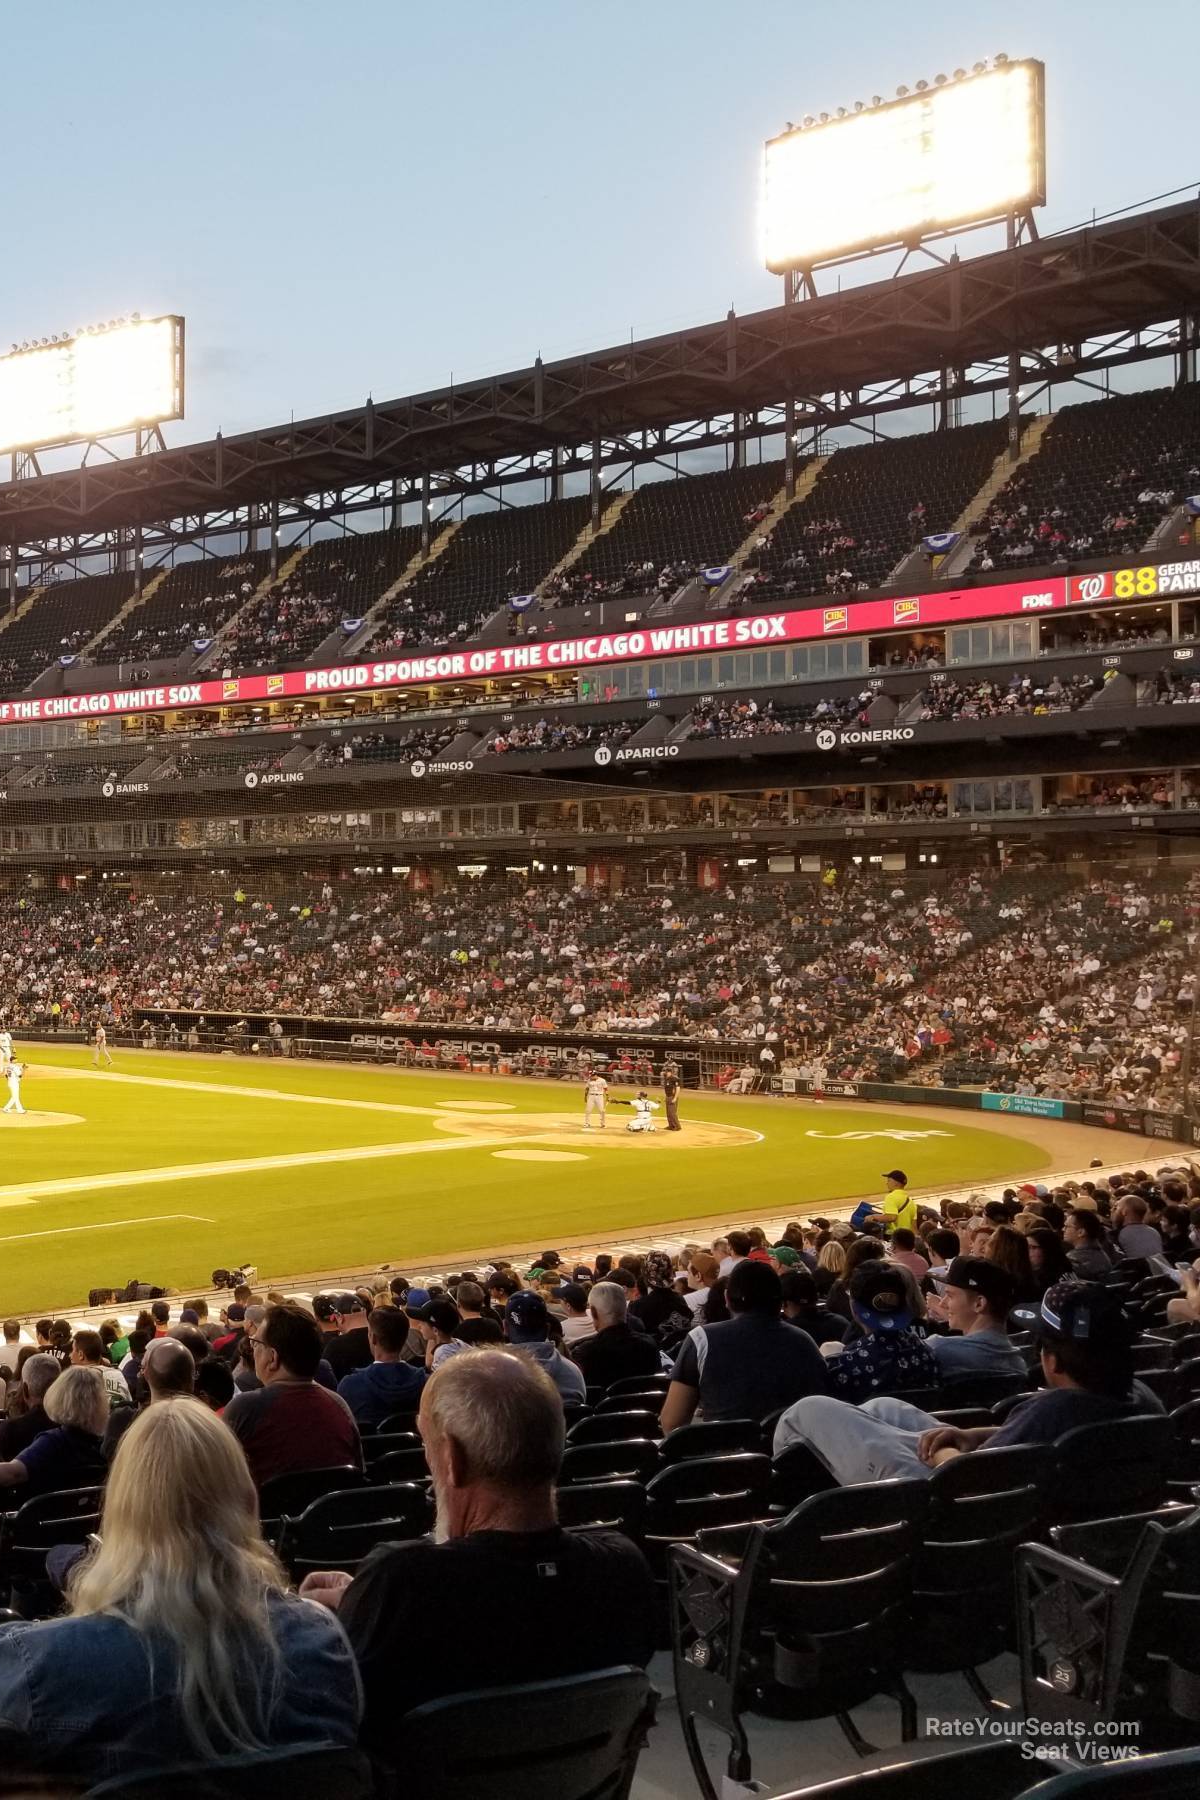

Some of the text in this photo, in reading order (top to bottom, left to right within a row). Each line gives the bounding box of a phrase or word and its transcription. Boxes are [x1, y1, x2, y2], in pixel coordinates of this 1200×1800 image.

[1115, 566, 1158, 598] 88
[896, 601, 918, 612] CIBC
[1022, 593, 1052, 609] FDIC
[825, 610, 846, 621] CIBC
[305, 616, 786, 690] PROUD SPONSOR OF THE CHICAGO WHITE SOX
[13, 703, 40, 719] THE
[44, 694, 111, 716] CHICAGO
[113, 690, 165, 709] WHITE
[168, 685, 202, 703] SOX
[820, 728, 915, 746] 14 KONERKO
[598, 745, 680, 761] 11 APARICIO
[428, 761, 474, 773] MINOSO
[261, 772, 304, 784] APPLING
[116, 782, 149, 794] BAINES
[350, 1033, 409, 1051] GEICO
[617, 1047, 655, 1058] GEICO
[664, 1050, 700, 1061] GEICO
[695, 1649, 706, 1659] 22
[1055, 1670, 1070, 1682] 23
